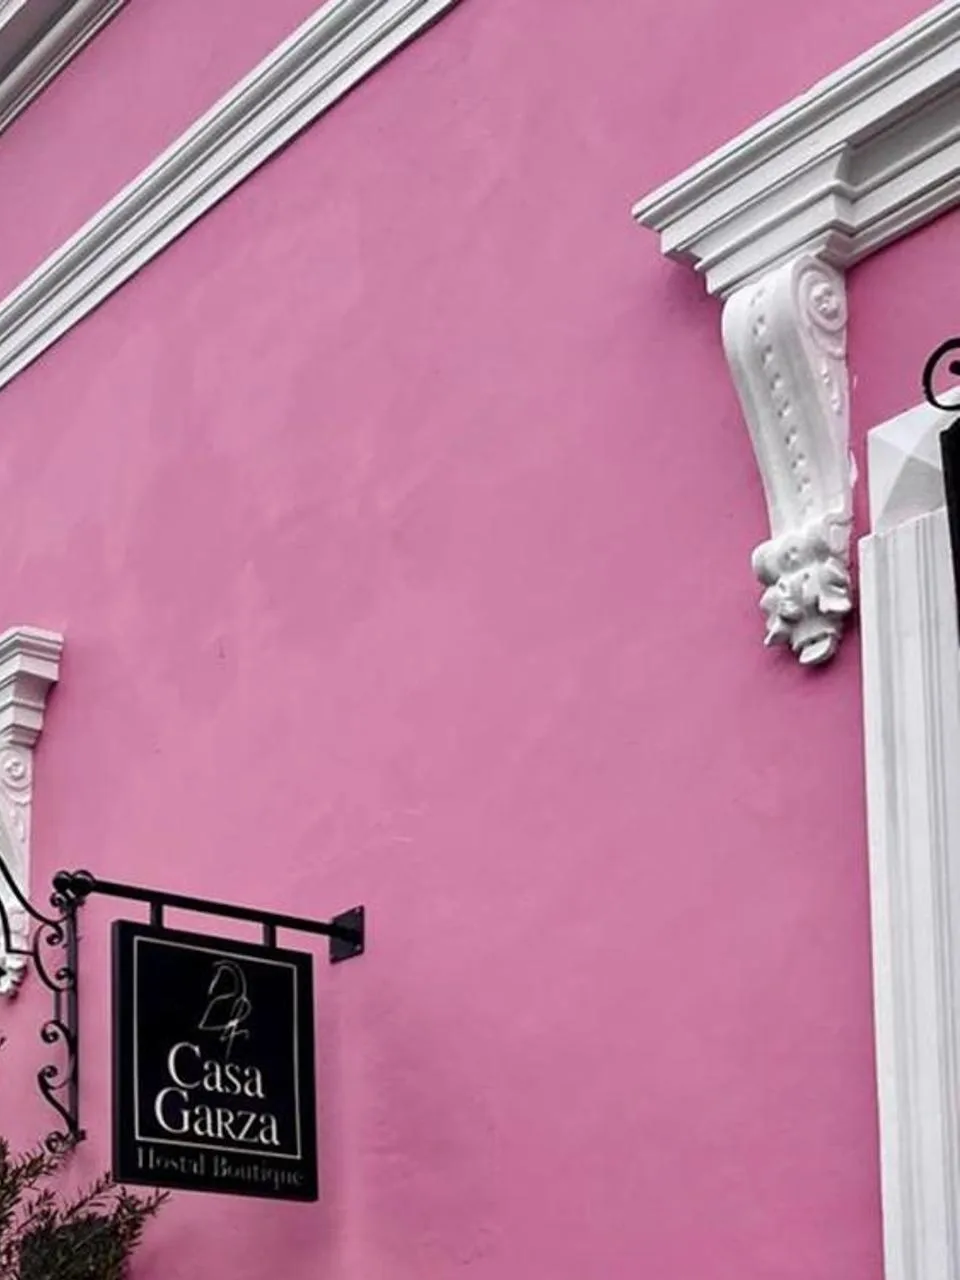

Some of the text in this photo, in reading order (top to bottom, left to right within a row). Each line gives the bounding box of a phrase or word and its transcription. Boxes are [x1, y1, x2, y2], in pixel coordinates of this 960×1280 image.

[167, 1041, 265, 1099] Casa
[137, 1147, 304, 1190] Hostal Boutique
